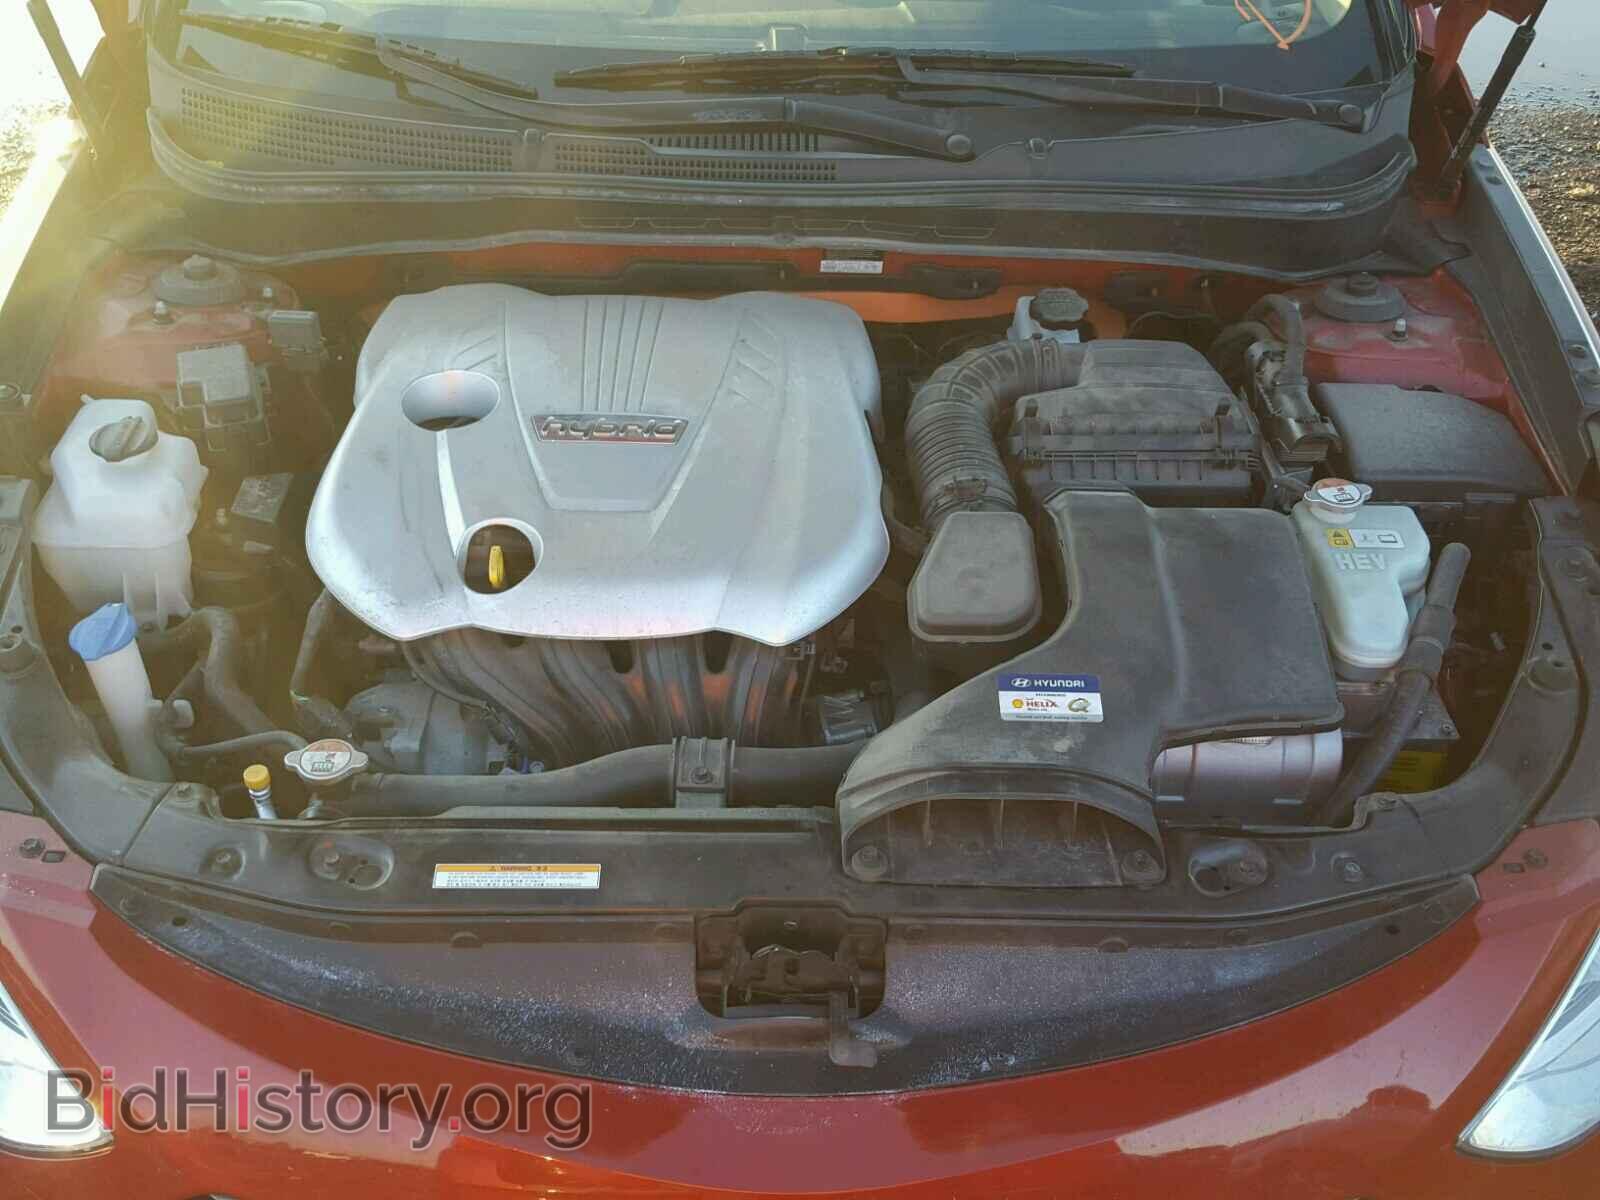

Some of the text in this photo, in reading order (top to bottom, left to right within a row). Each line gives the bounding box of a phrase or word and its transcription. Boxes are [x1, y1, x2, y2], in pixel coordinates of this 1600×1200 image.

[1334, 552, 1386, 571] HEV
[1033, 679, 1085, 688] HYUNDAI
[1025, 699, 1057, 708] HELIX
